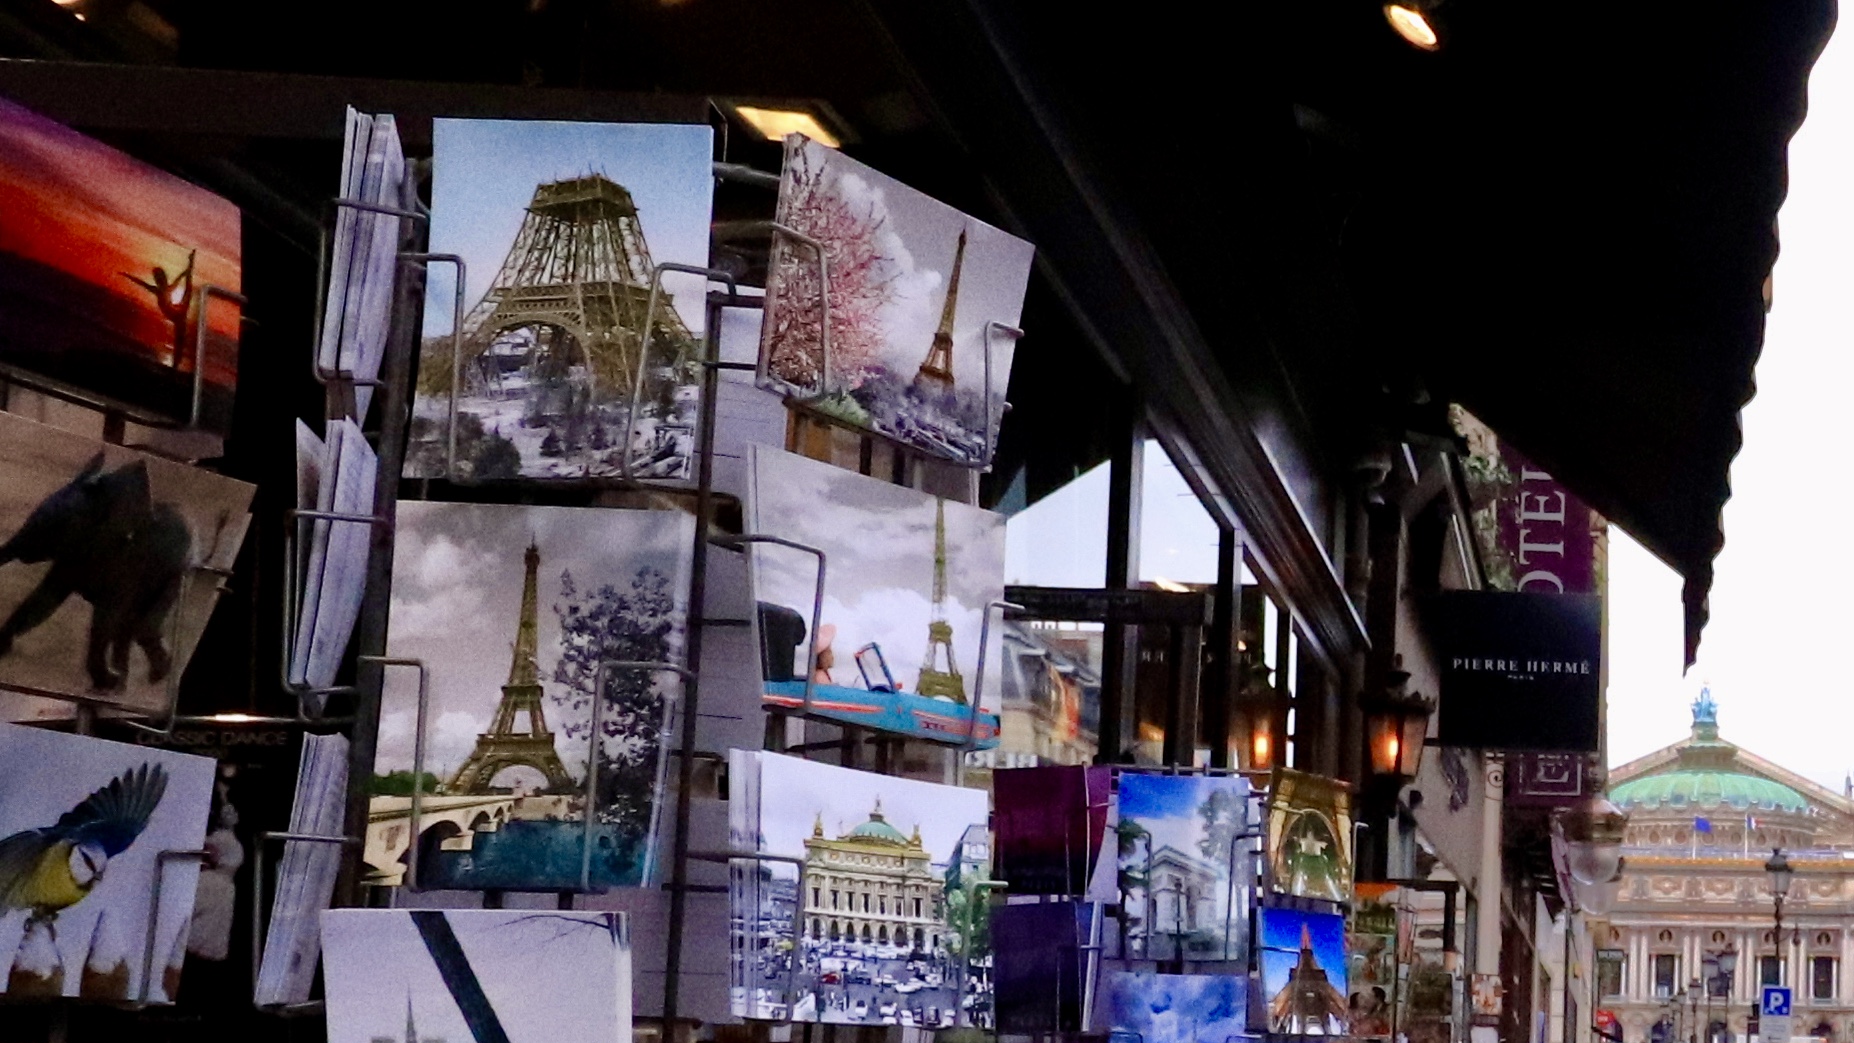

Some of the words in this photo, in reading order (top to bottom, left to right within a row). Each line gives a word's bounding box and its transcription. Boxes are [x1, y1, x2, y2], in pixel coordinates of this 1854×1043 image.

[1453, 658, 1519, 673] PIERRE
[1526, 659, 1591, 675] HERMÉ
[1769, 991, 1784, 1011] P
